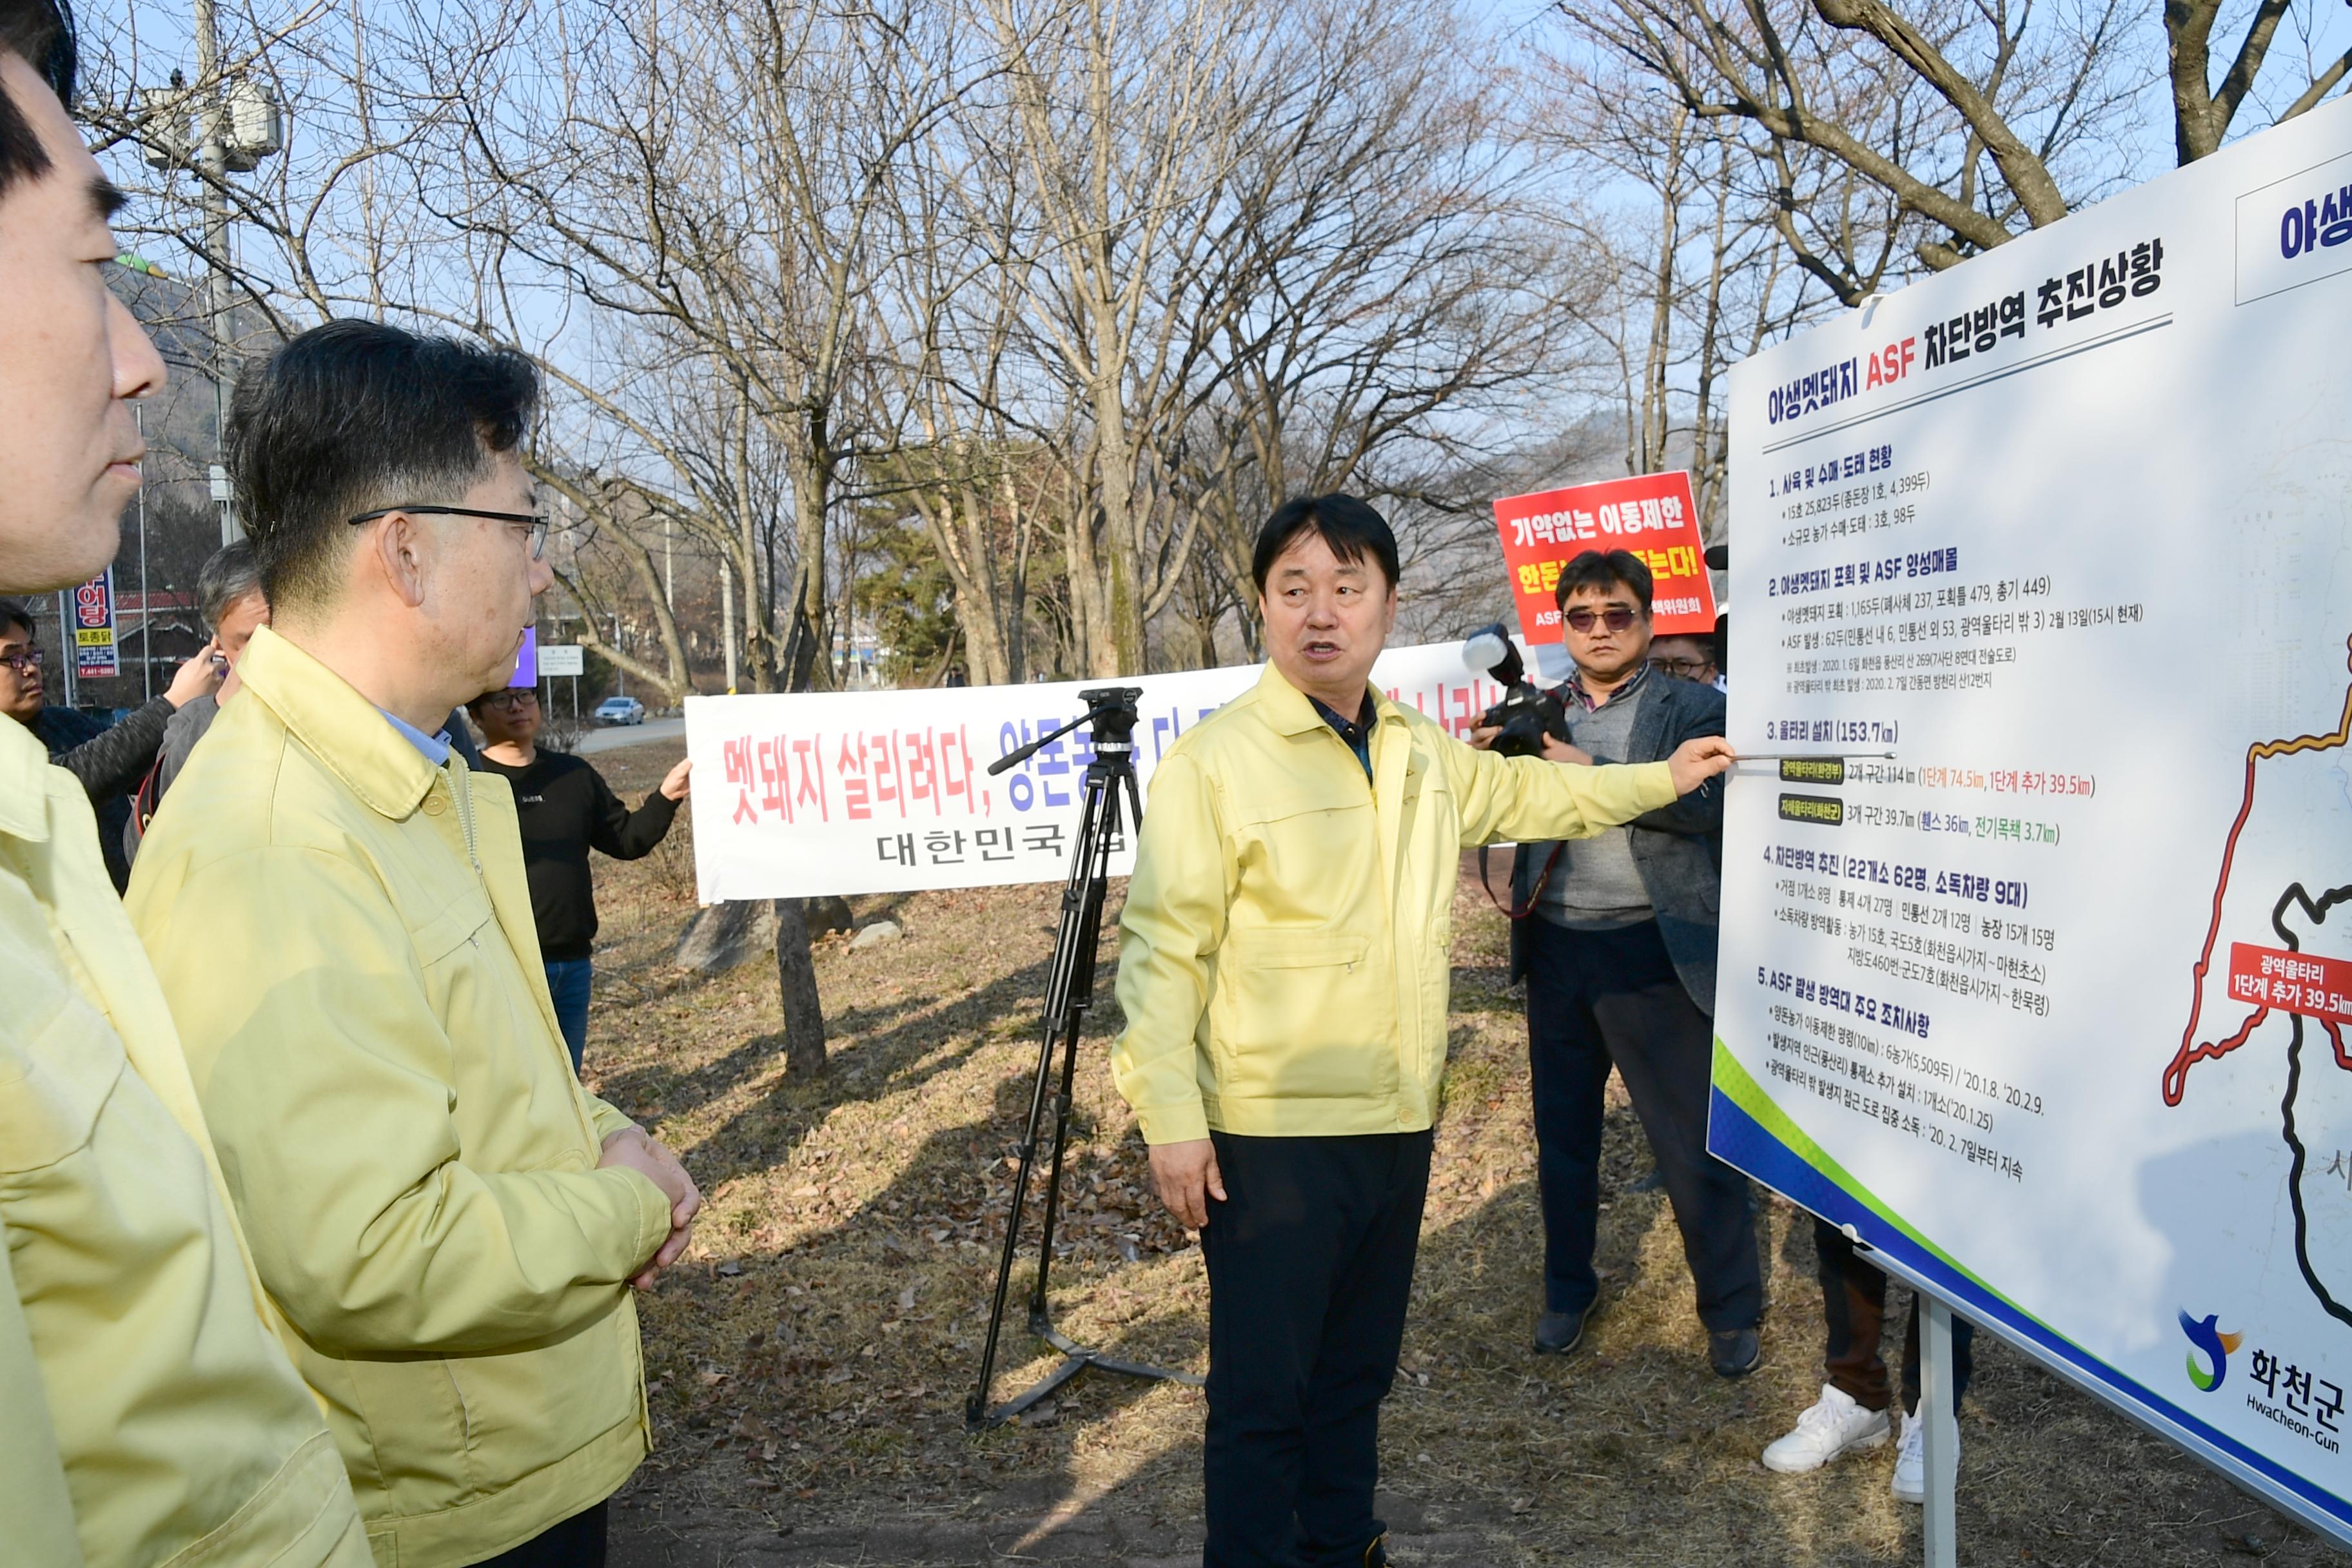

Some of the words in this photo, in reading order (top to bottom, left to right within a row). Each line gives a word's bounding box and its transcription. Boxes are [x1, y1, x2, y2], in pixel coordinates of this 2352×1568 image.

[1769, 357, 1858, 425] 야생멧돼지
[1866, 337, 1916, 391] ASF
[1924, 290, 2025, 370] 차단방역
[2037, 237, 2164, 329] 추진상황
[1783, 471, 1801, 494] 사육
[1805, 467, 1814, 489] 및
[1819, 453, 1865, 484] 수매·도태
[1870, 444, 1892, 472] 현황
[1788, 503, 1803, 519] 15호
[1805, 485, 1869, 516] 25,823두(종돈장
[1872, 482, 1886, 500] 1호,
[1890, 471, 1930, 496] 4,399두)
[1510, 509, 1596, 547] 기약없는
[1599, 496, 1685, 534] 이동제한
[1788, 528, 1810, 546] 소규모
[1813, 524, 1828, 542] 농가
[1830, 514, 1865, 538] 수매·도태
[1874, 510, 1890, 528] 3호,
[1894, 505, 1915, 524] 98두
[1781, 568, 1830, 595] 야생멧돼지
[1835, 564, 1854, 587] 포획
[1860, 562, 1869, 584] 및
[1875, 558, 1901, 582] ASF
[1906, 547, 1957, 577] 양성매몰
[1787, 604, 1824, 624] 야생멧돼지
[1828, 602, 1843, 619] 포획
[1852, 593, 1910, 618] 1,165두(폐사체
[1915, 592, 1933, 610] 237,
[1937, 586, 1966, 607] 포획틀
[1970, 584, 1992, 603] 479,
[1997, 579, 2018, 602] 총기
[2023, 576, 2050, 596] 449)
[79, 631, 111, 642] 토종닭
[1787, 634, 1801, 649] ASF
[1804, 632, 1819, 649] 발생
[1826, 626, 1872, 647] 62두(민통선
[1876, 625, 1884, 643] 내
[1888, 626, 1895, 643] 6,
[1899, 621, 1926, 642] 민통선
[1930, 620, 1939, 640] 외
[1943, 620, 1957, 638] 53,
[1961, 612, 2014, 637] 광역울타리
[2019, 611, 2030, 632] 밖
[2034, 610, 2044, 630] 3)
[2050, 611, 2064, 629] 2월
[2068, 606, 2113, 627] 13일(15시
[2118, 603, 2142, 623] 현재)
[1780, 721, 1808, 741] 울타리
[1812, 720, 1832, 741] 설치
[723, 732, 828, 825] 멧돼지
[837, 723, 991, 819] 살리려다,
[877, 824, 1066, 867] 대한민국
[1776, 845, 1814, 872] 차단방역
[1819, 852, 1839, 876] 추진
[1843, 856, 1888, 884] (22개소
[1894, 865, 1929, 892] 62명,
[1936, 871, 1990, 902] 소독차량
[1995, 881, 2027, 909] 9대)
[1781, 879, 1795, 897] 거점
[1798, 883, 1815, 899] 1개소
[1818, 887, 1830, 904] 8명
[1839, 890, 1854, 909] 통제
[1857, 895, 1871, 913] 4개
[1874, 897, 1892, 917] 27명
[1902, 903, 1928, 925] 민통선
[1932, 908, 1947, 928] 2개
[1951, 912, 1970, 933] 12명
[1981, 917, 2003, 939] 농장
[2006, 923, 2028, 946] 15개
[2032, 928, 2054, 951] 15명
[2233, 974, 2268, 1001] 1단계
[2271, 979, 2302, 1008] 추가
[2260, 955, 2324, 985] 광역울타리
[1770, 970, 1792, 992] ASF
[1796, 977, 1815, 1001] 발생
[1819, 985, 1850, 1012] 방역대
[1855, 995, 1876, 1021] 주요
[1881, 1003, 1929, 1038] 조치사항
[2250, 1349, 2345, 1433] 화천군
[2247, 1394, 2340, 1455] HwaCheon-Gun
